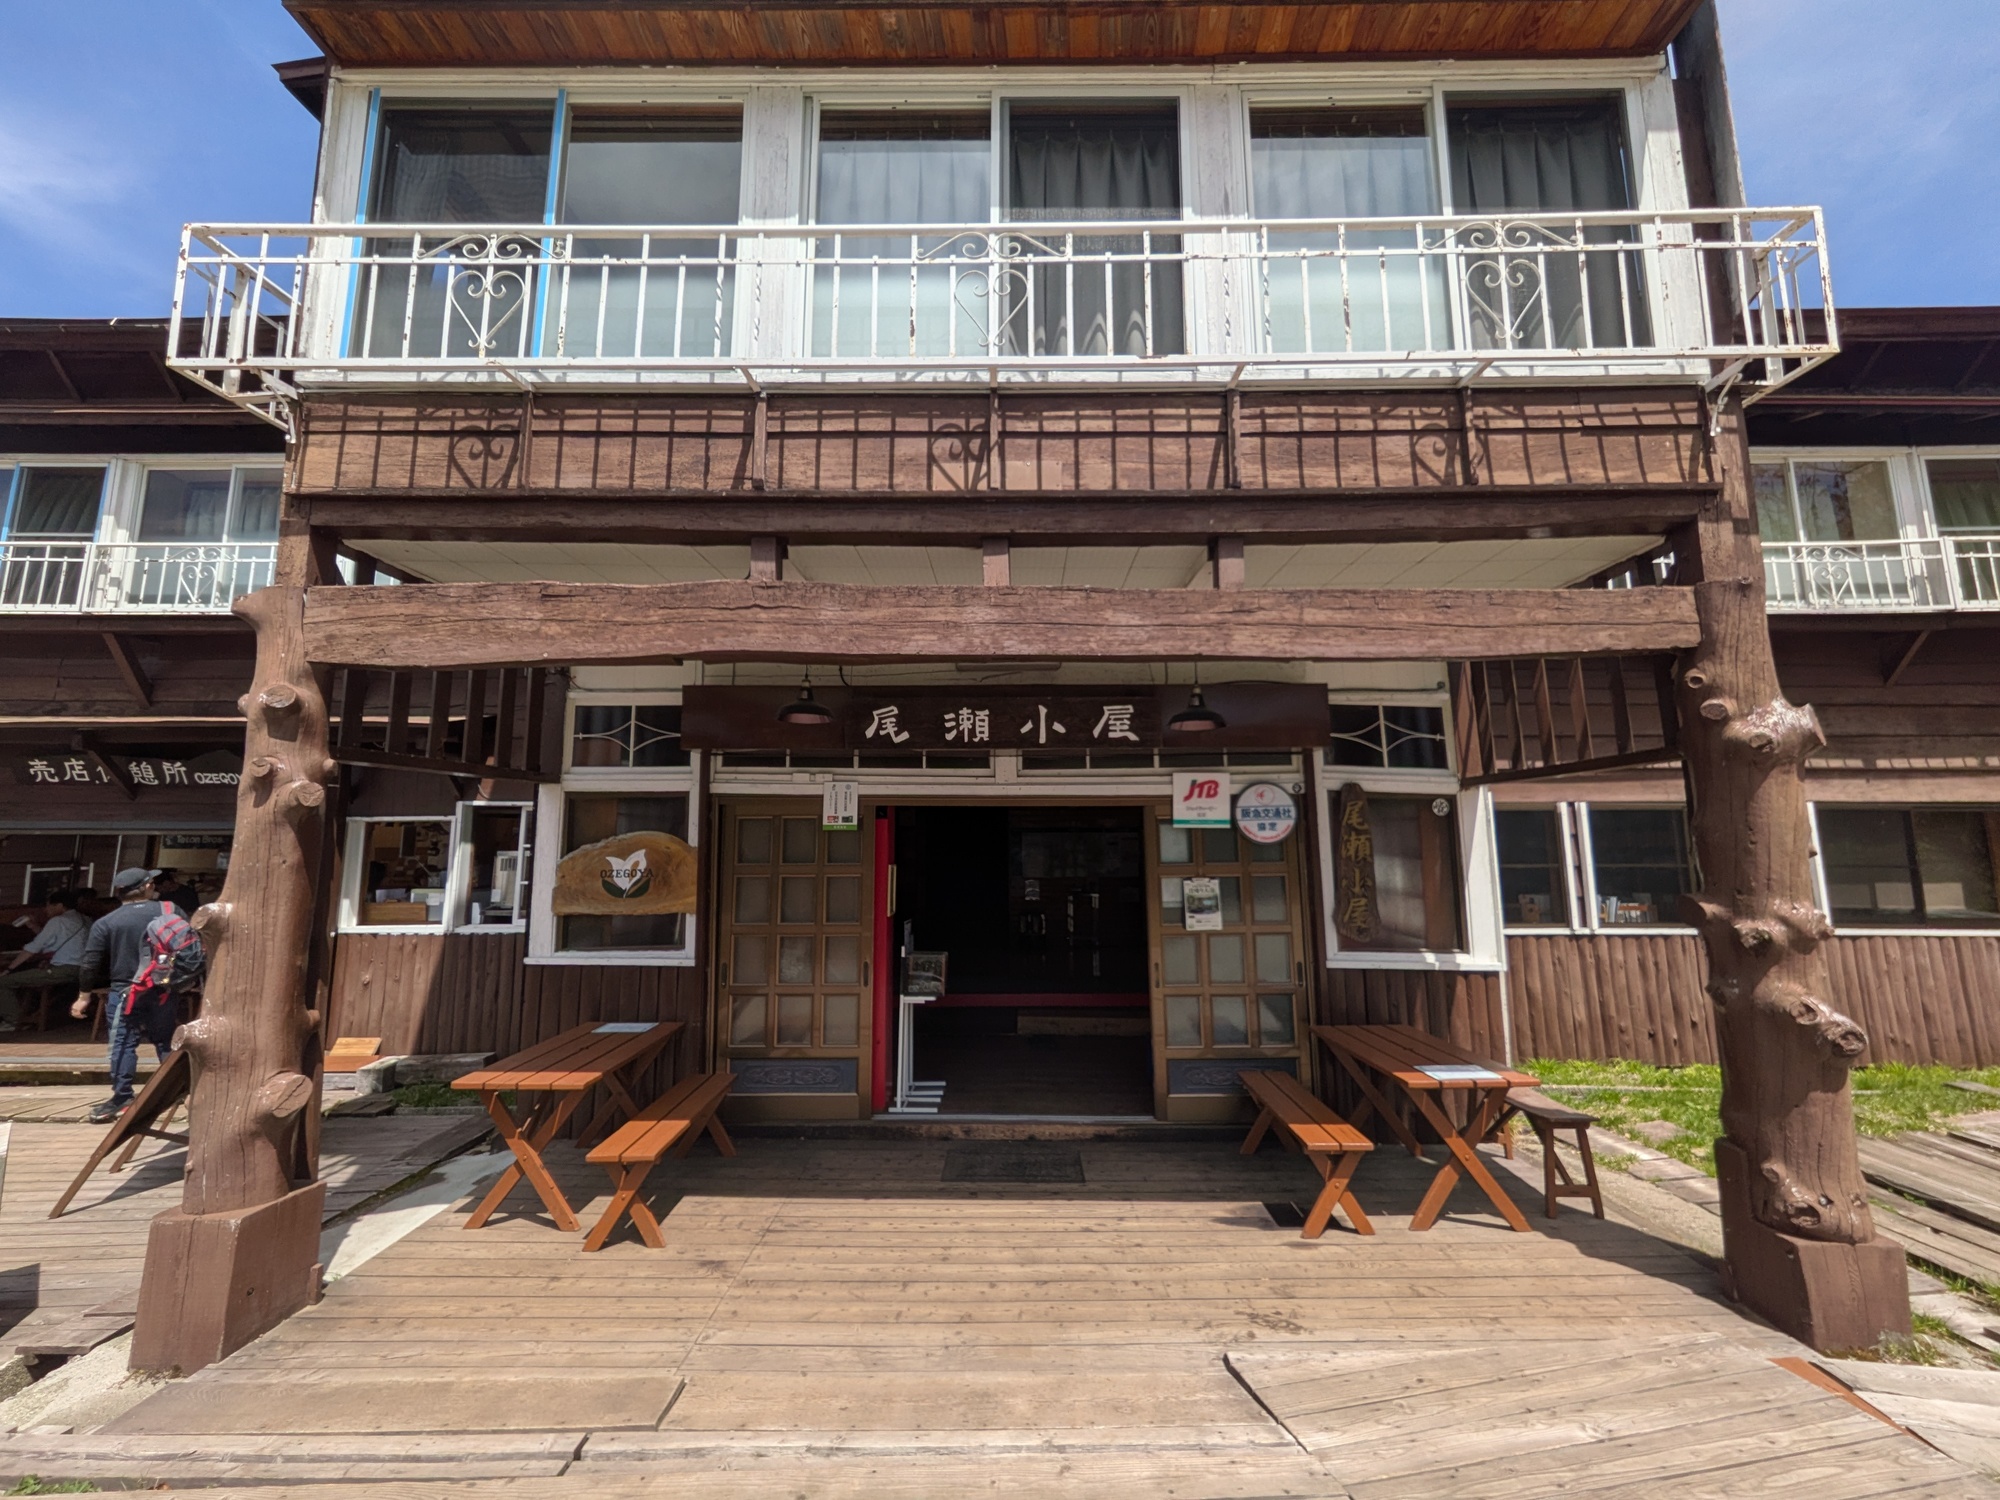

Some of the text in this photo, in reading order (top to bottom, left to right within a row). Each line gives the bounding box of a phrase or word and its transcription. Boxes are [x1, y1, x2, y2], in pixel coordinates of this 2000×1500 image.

[865, 704, 1140, 744] 尾瀬小屋
[1183, 779, 1219, 802] JTB
[600, 868, 654, 879] OZEGOYA
[1342, 800, 1373, 928] 尾瀬小屋
